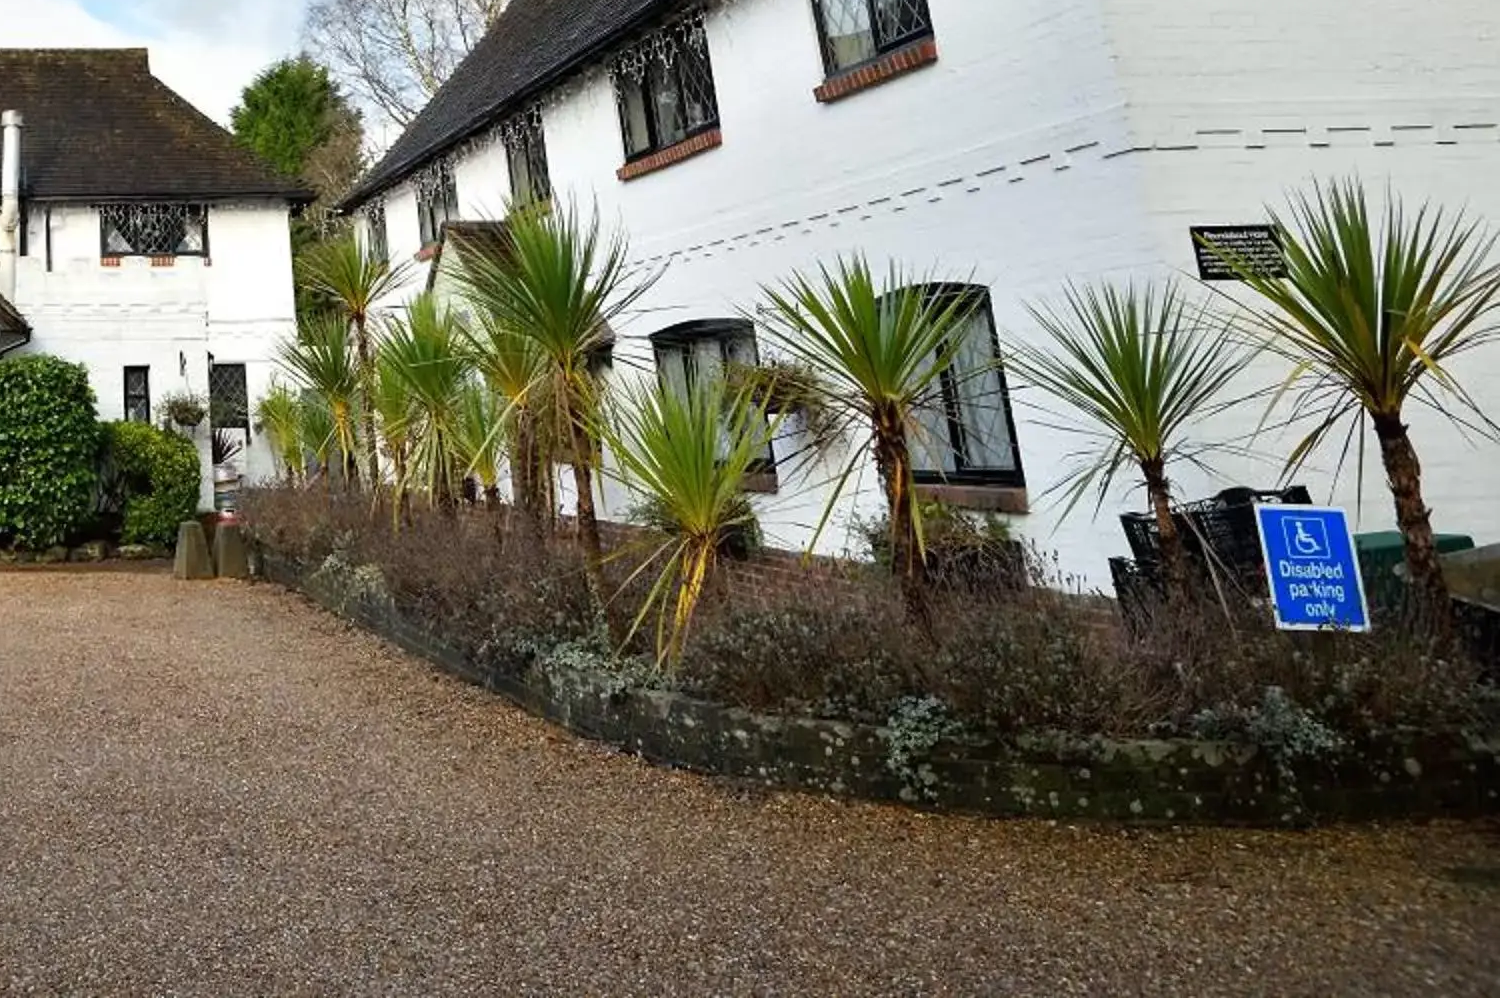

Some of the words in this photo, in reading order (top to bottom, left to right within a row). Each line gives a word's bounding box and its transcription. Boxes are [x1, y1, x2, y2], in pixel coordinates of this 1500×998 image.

[1280, 560, 1344, 579] Disabled
[1289, 580, 1345, 602] parking
[1305, 600, 1336, 617] only
